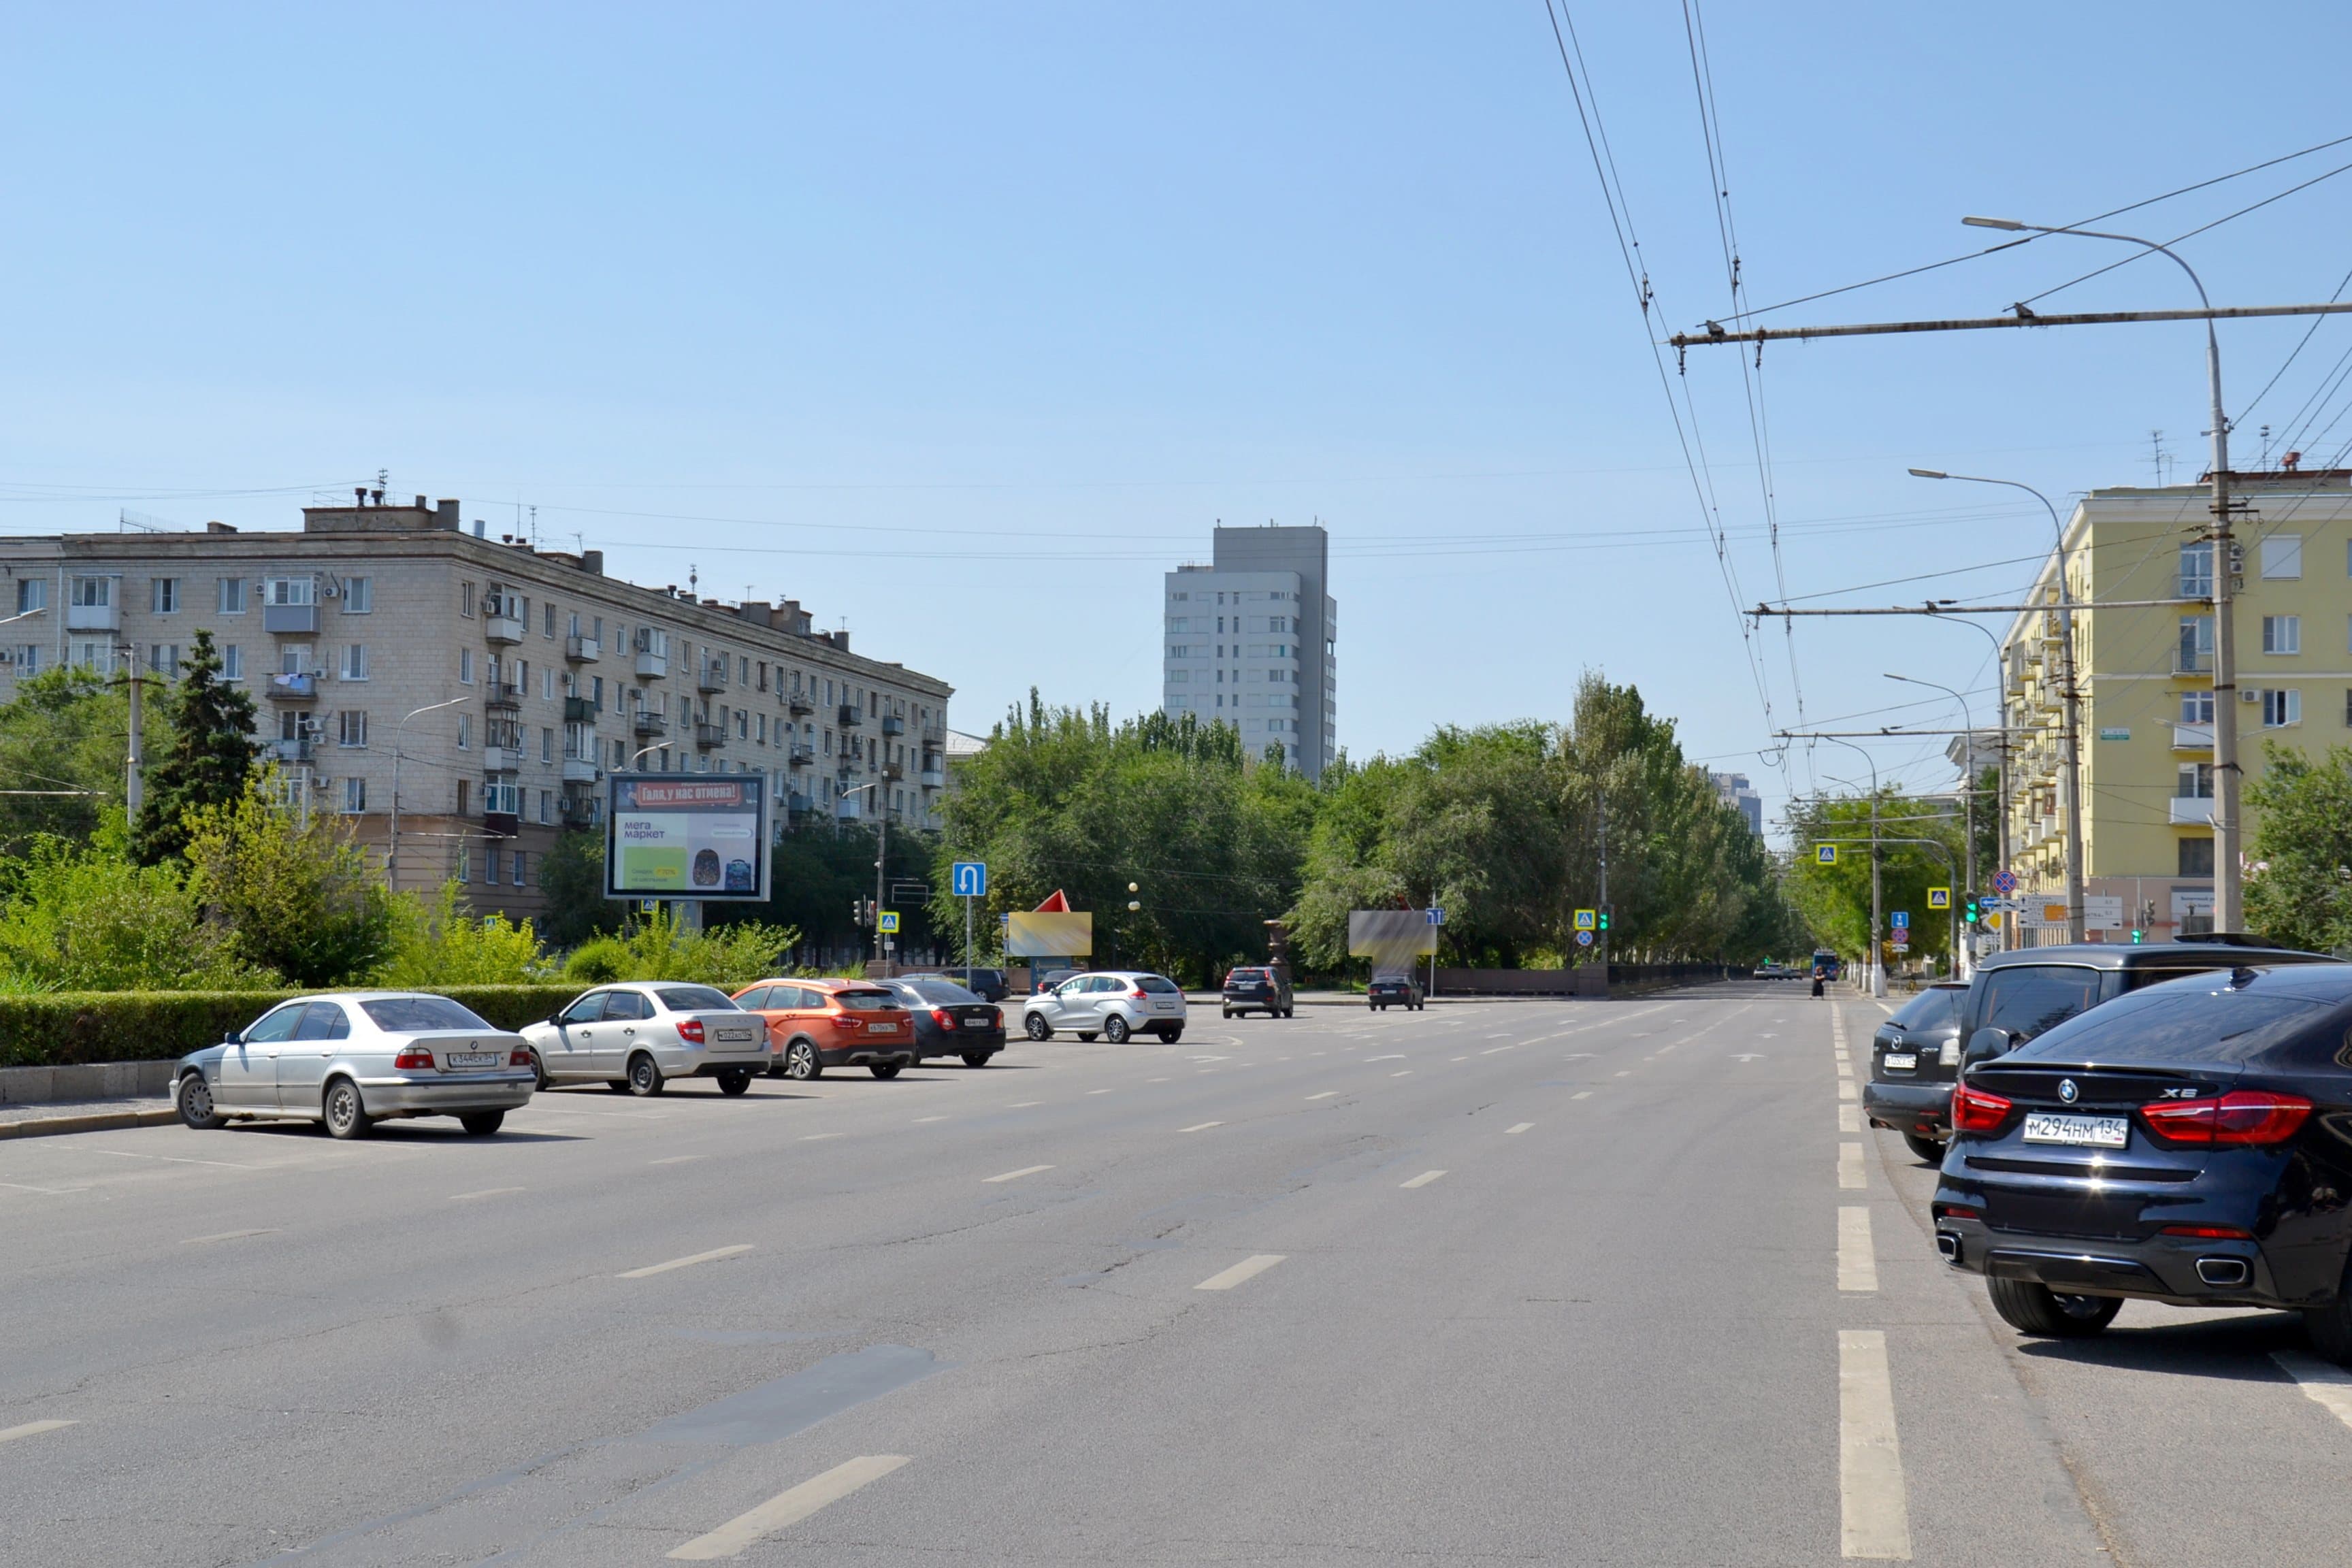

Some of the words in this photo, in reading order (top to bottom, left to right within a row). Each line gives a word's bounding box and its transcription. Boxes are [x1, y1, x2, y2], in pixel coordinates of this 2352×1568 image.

[676, 788, 693, 800] нас
[696, 785, 736, 799] отмена!
[624, 821, 651, 830] мега
[624, 830, 665, 840] маркет
[2159, 1088, 2198, 1098] X6
[2031, 1117, 2094, 1139] М294НМ
[2097, 1119, 2121, 1135] 134
